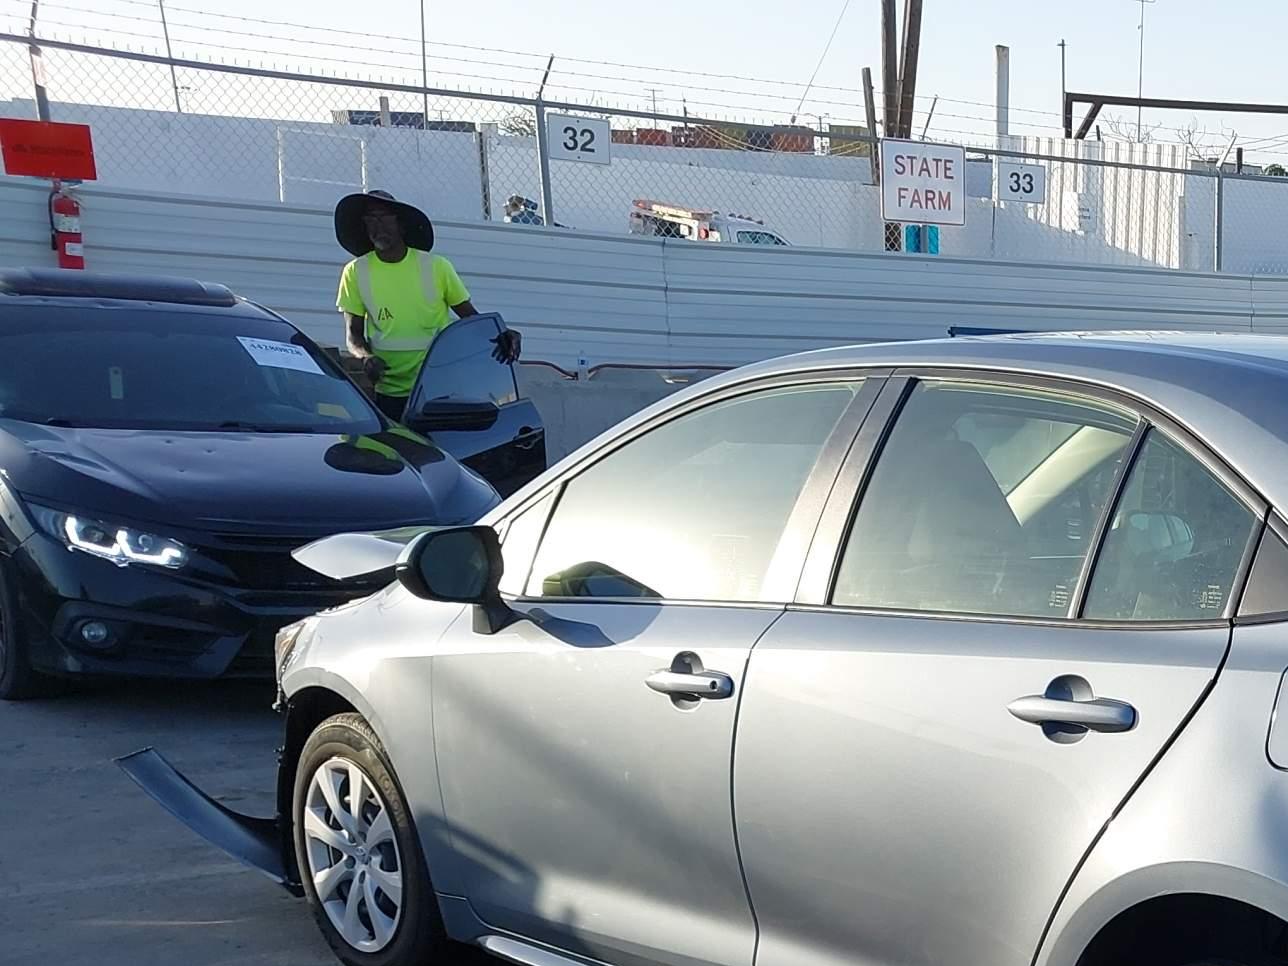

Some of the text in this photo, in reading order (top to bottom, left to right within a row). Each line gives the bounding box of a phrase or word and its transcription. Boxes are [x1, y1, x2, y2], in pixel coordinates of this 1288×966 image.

[563, 126, 596, 153] 32
[894, 154, 955, 181] STATE
[1009, 172, 1034, 194] 33
[897, 187, 952, 212] FARM
